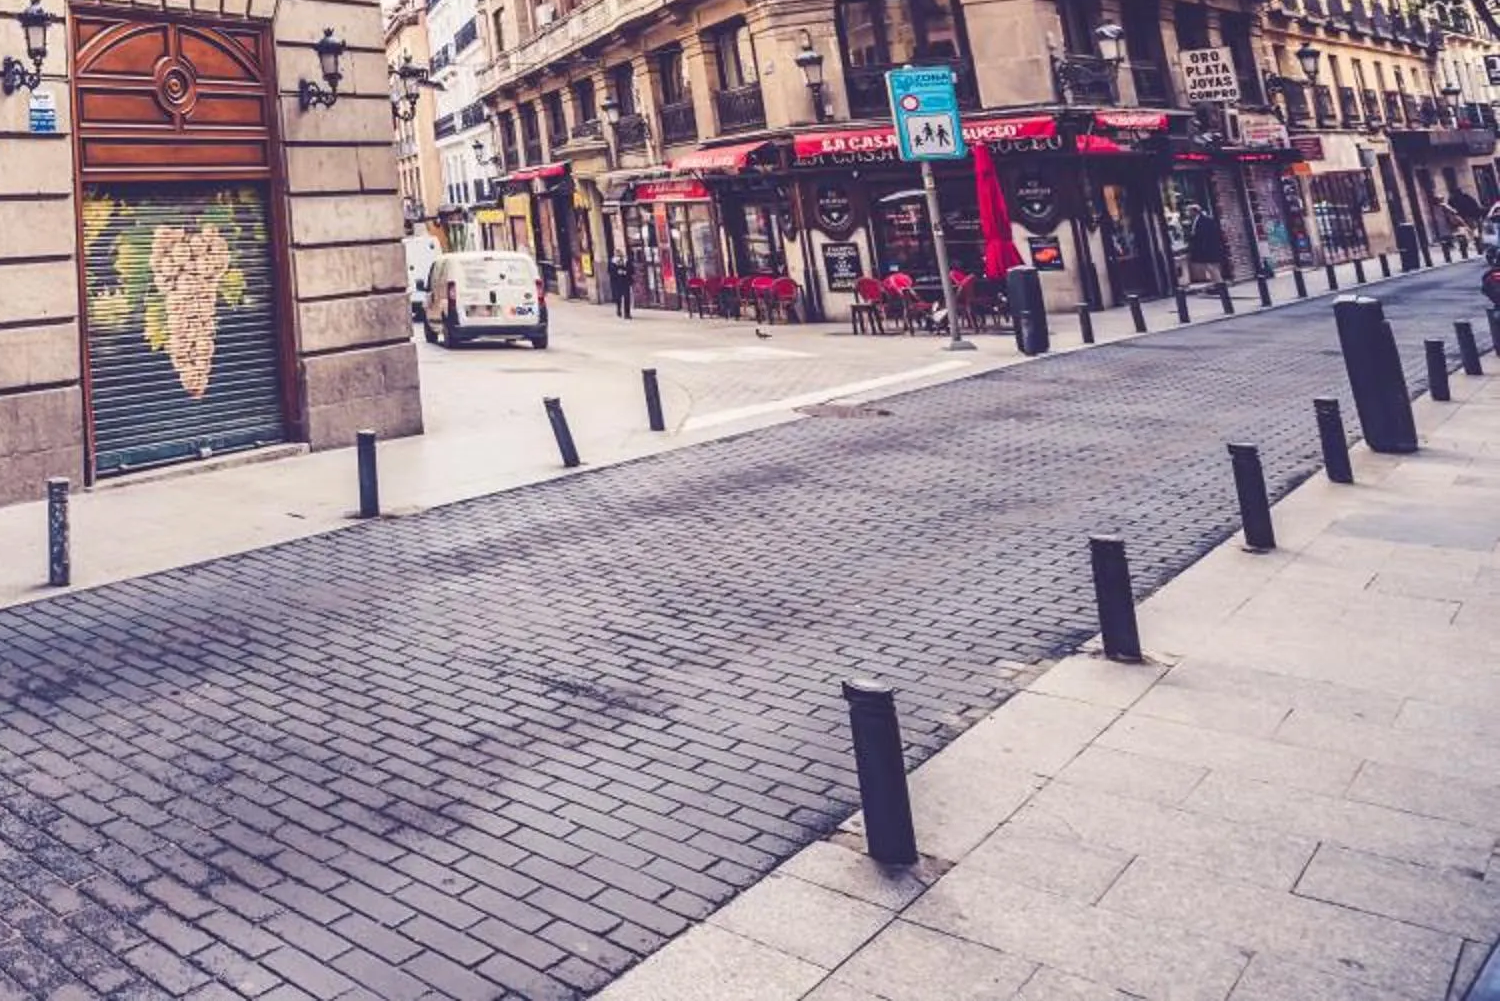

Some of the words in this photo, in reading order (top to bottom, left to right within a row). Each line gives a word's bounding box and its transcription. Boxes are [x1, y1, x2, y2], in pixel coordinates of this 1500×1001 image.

[1190, 51, 1219, 63] ORO
[1186, 63, 1230, 77] PLATA
[1190, 76, 1233, 89] JOYAS
[1190, 89, 1237, 99] COMPRO
[847, 134, 897, 150] CASA
